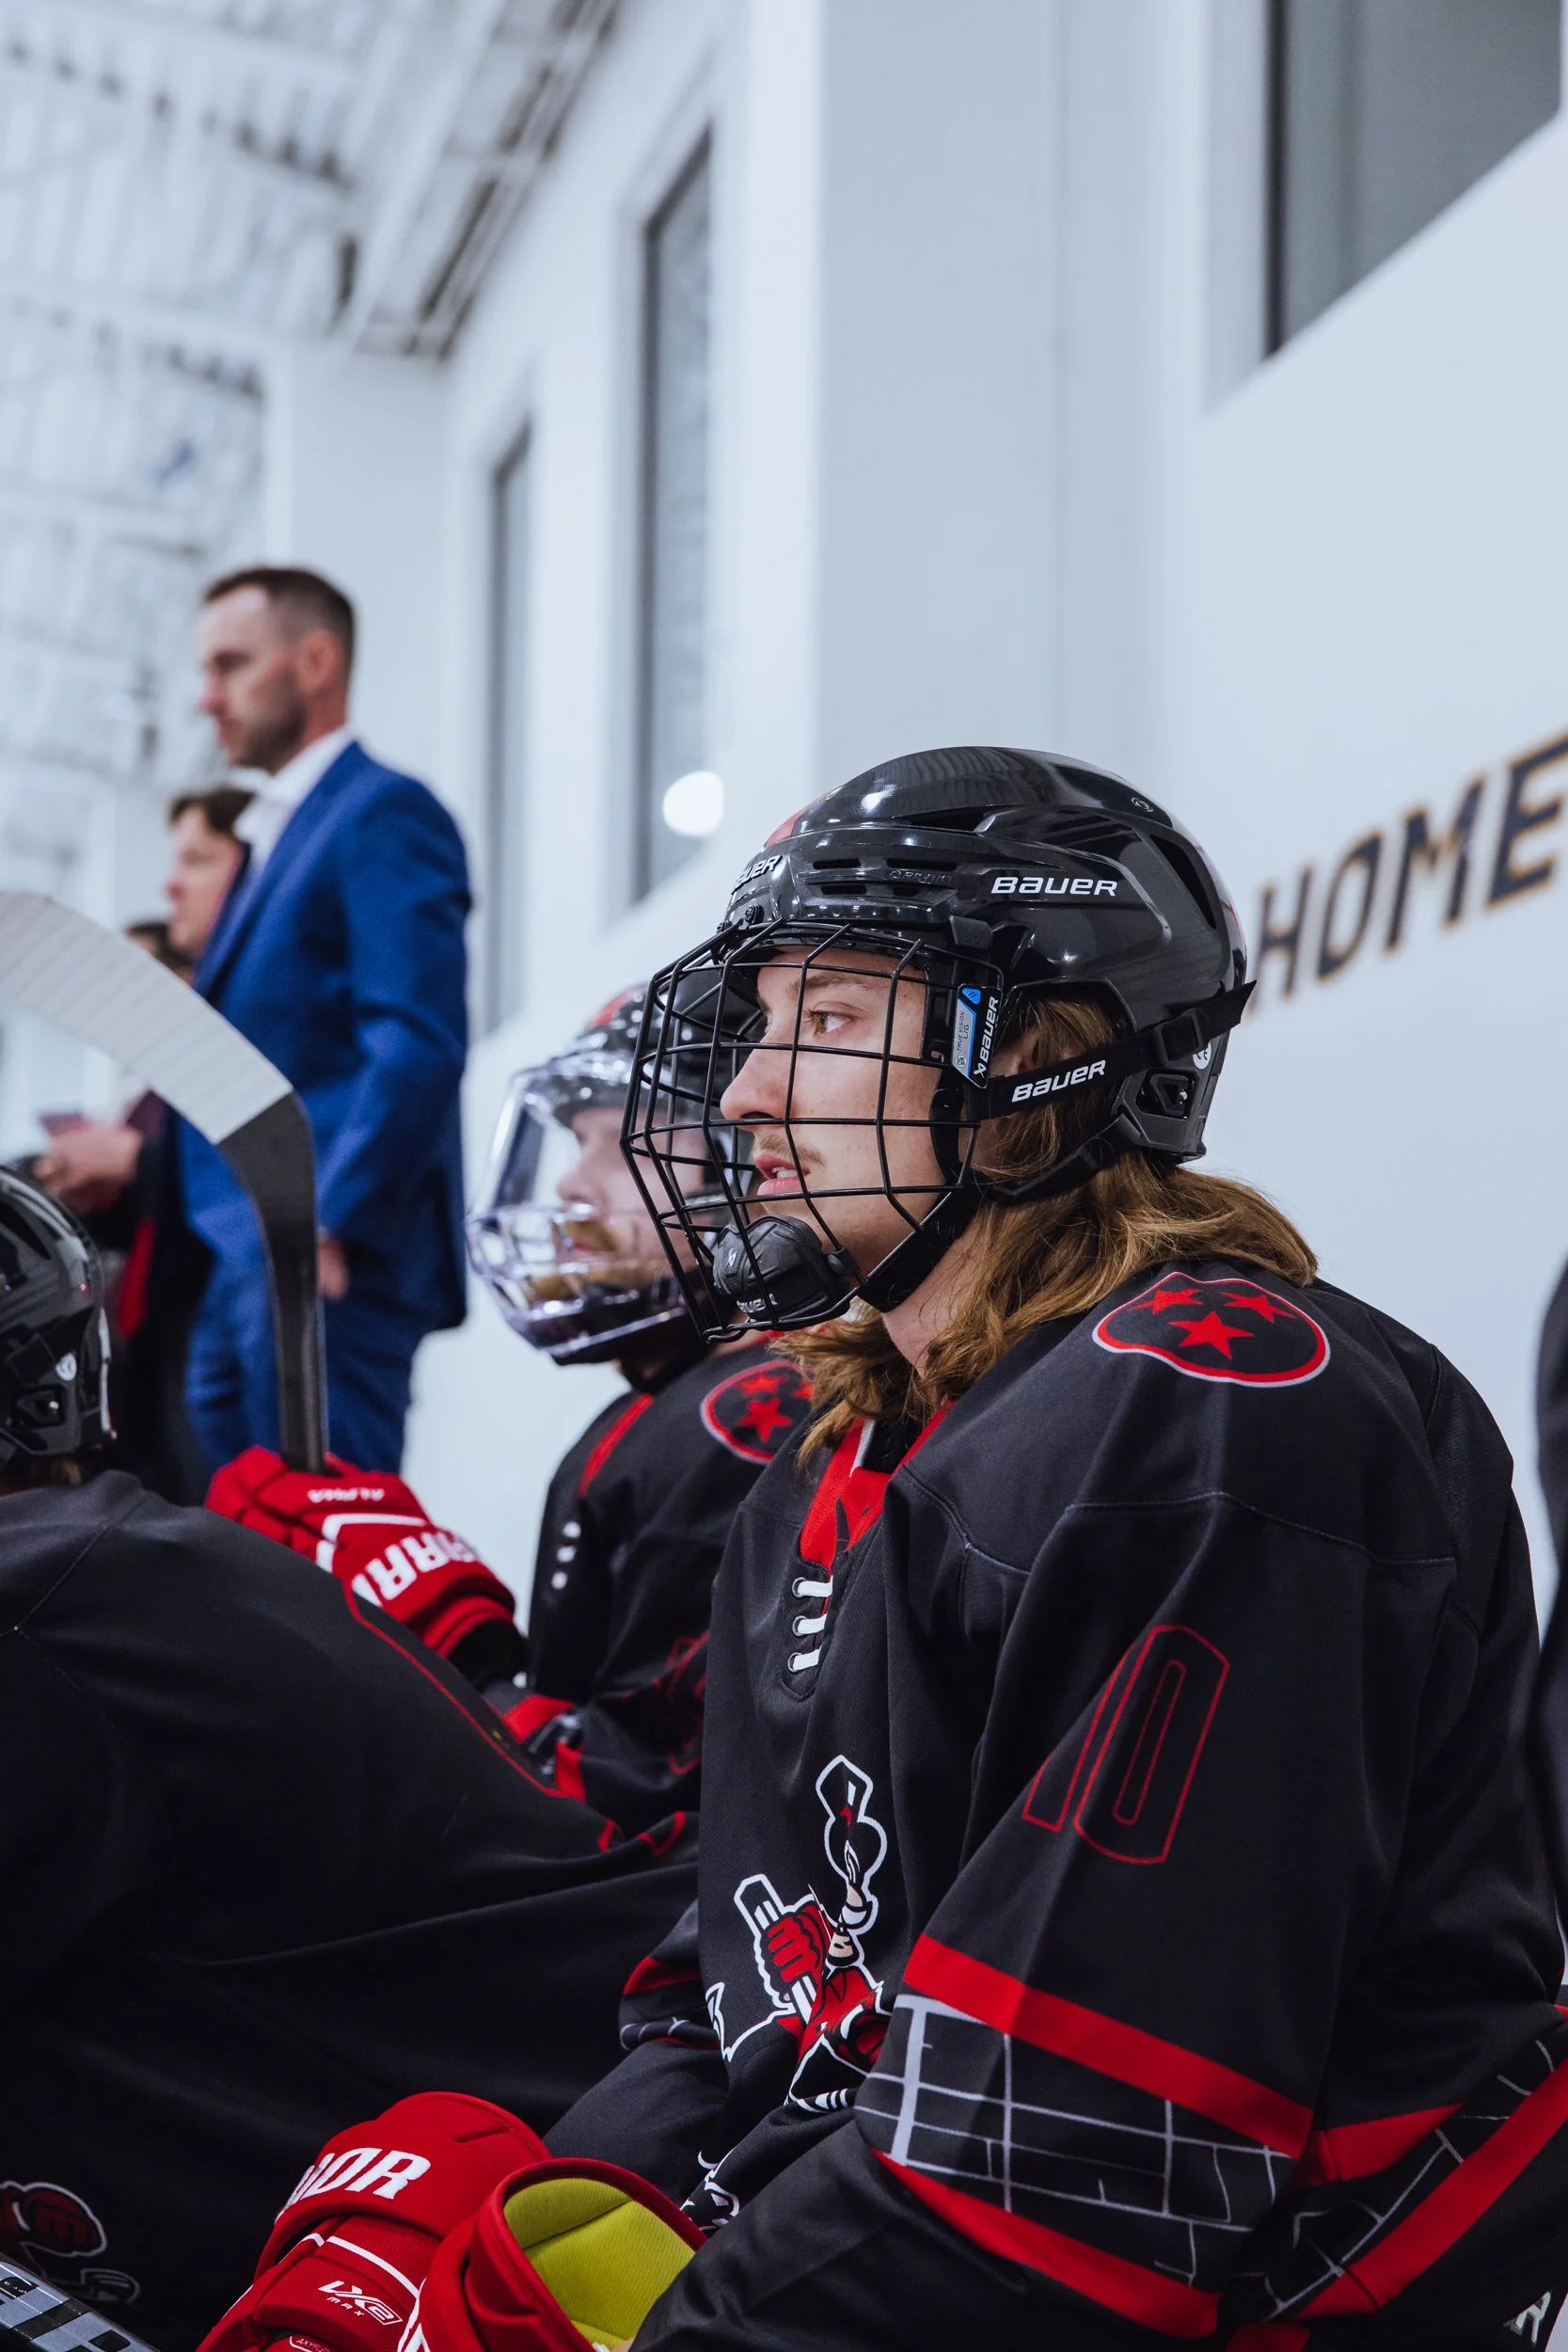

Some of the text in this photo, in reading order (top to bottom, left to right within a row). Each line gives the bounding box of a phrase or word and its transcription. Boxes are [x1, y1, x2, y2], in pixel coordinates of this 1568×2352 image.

[990, 876, 1118, 897] BAUER
[1243, 723, 1568, 1016] HOME
[979, 995, 999, 1064] BAUER
[1011, 1059, 1106, 1103] BAUER
